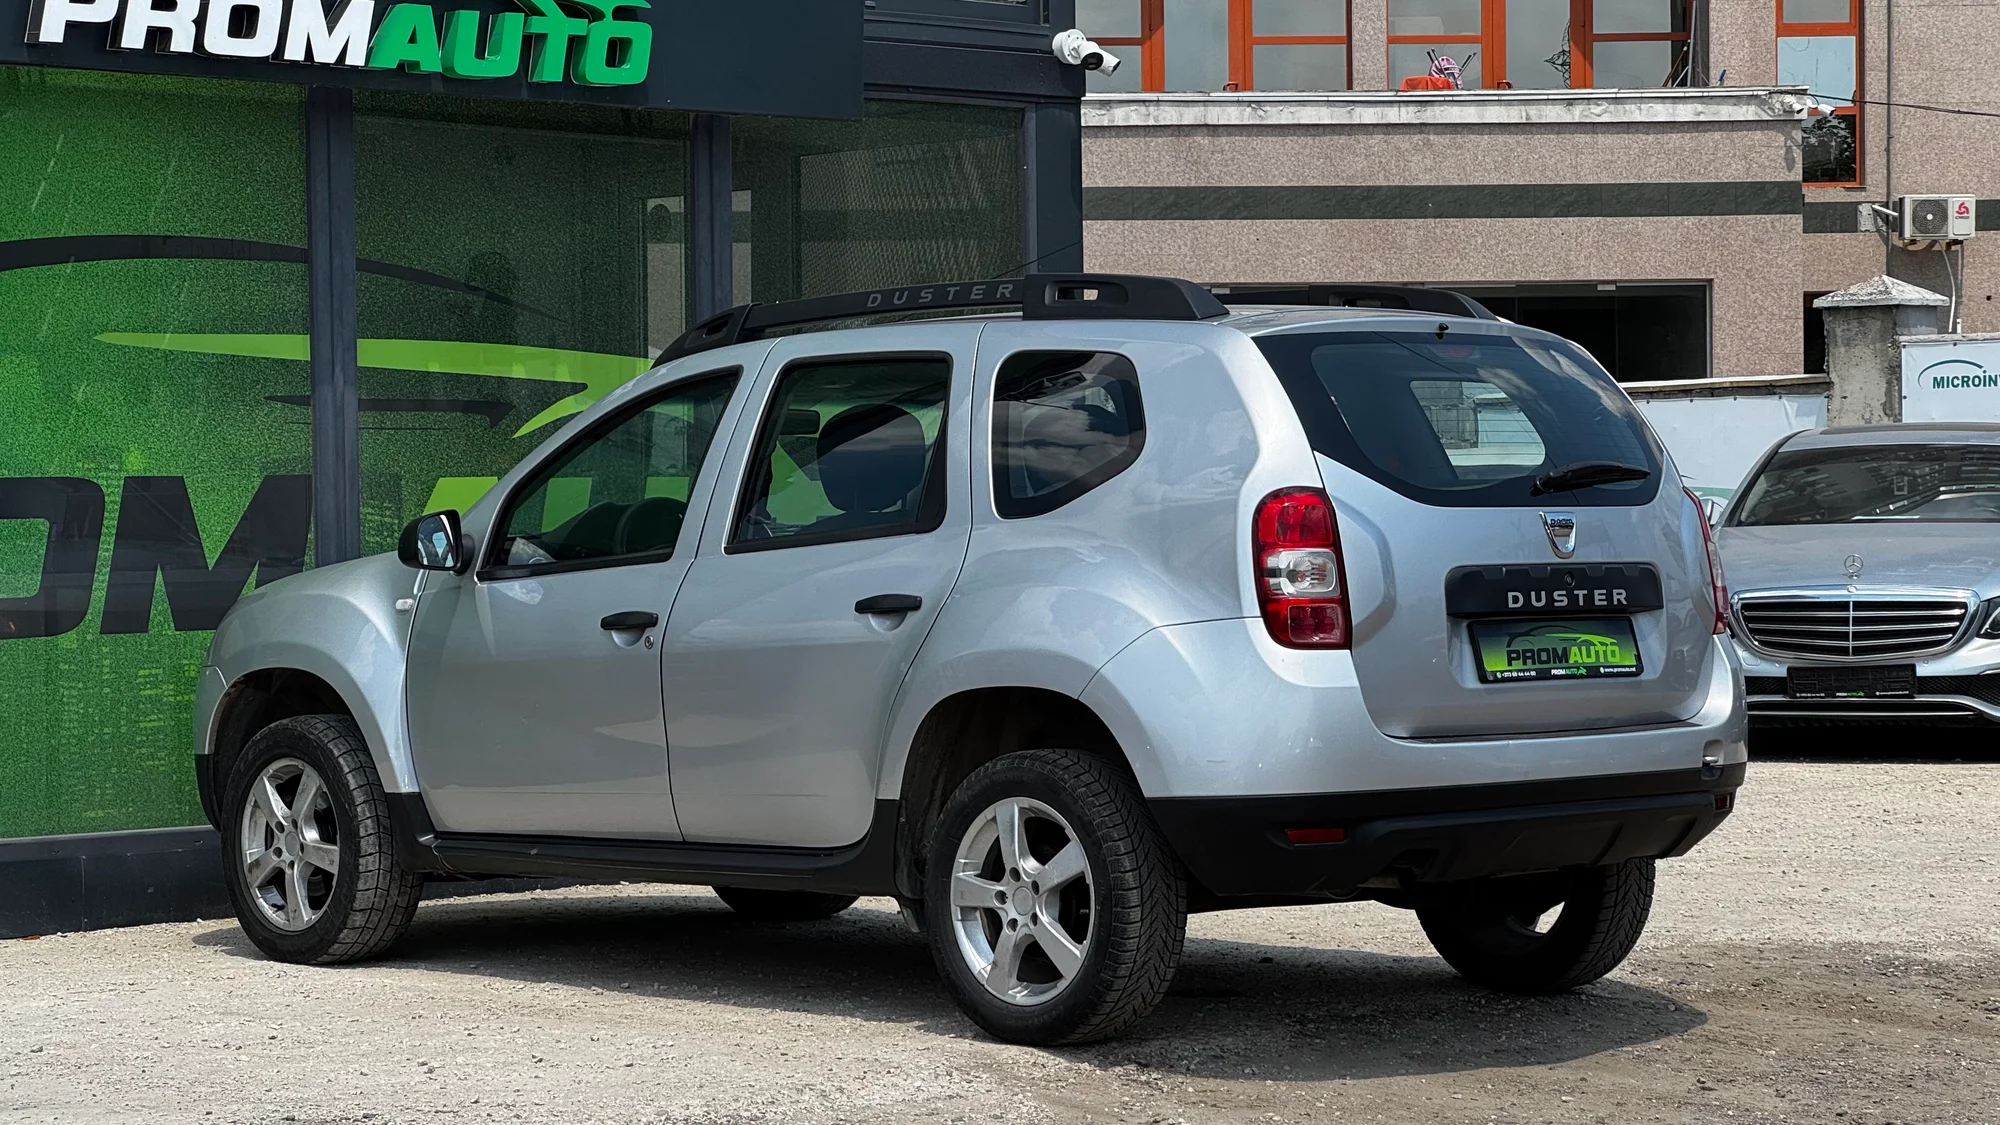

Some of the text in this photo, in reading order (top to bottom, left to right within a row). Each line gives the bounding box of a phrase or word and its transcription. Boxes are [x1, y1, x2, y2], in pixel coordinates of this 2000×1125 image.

[866, 283, 1014, 308] DUSTER
[1932, 369, 2000, 389] MICROIN
[1507, 588, 1628, 609] DUSTER
[1506, 645, 1620, 667] PROMAUTO
[1551, 667, 1578, 676] PROMAUTO
